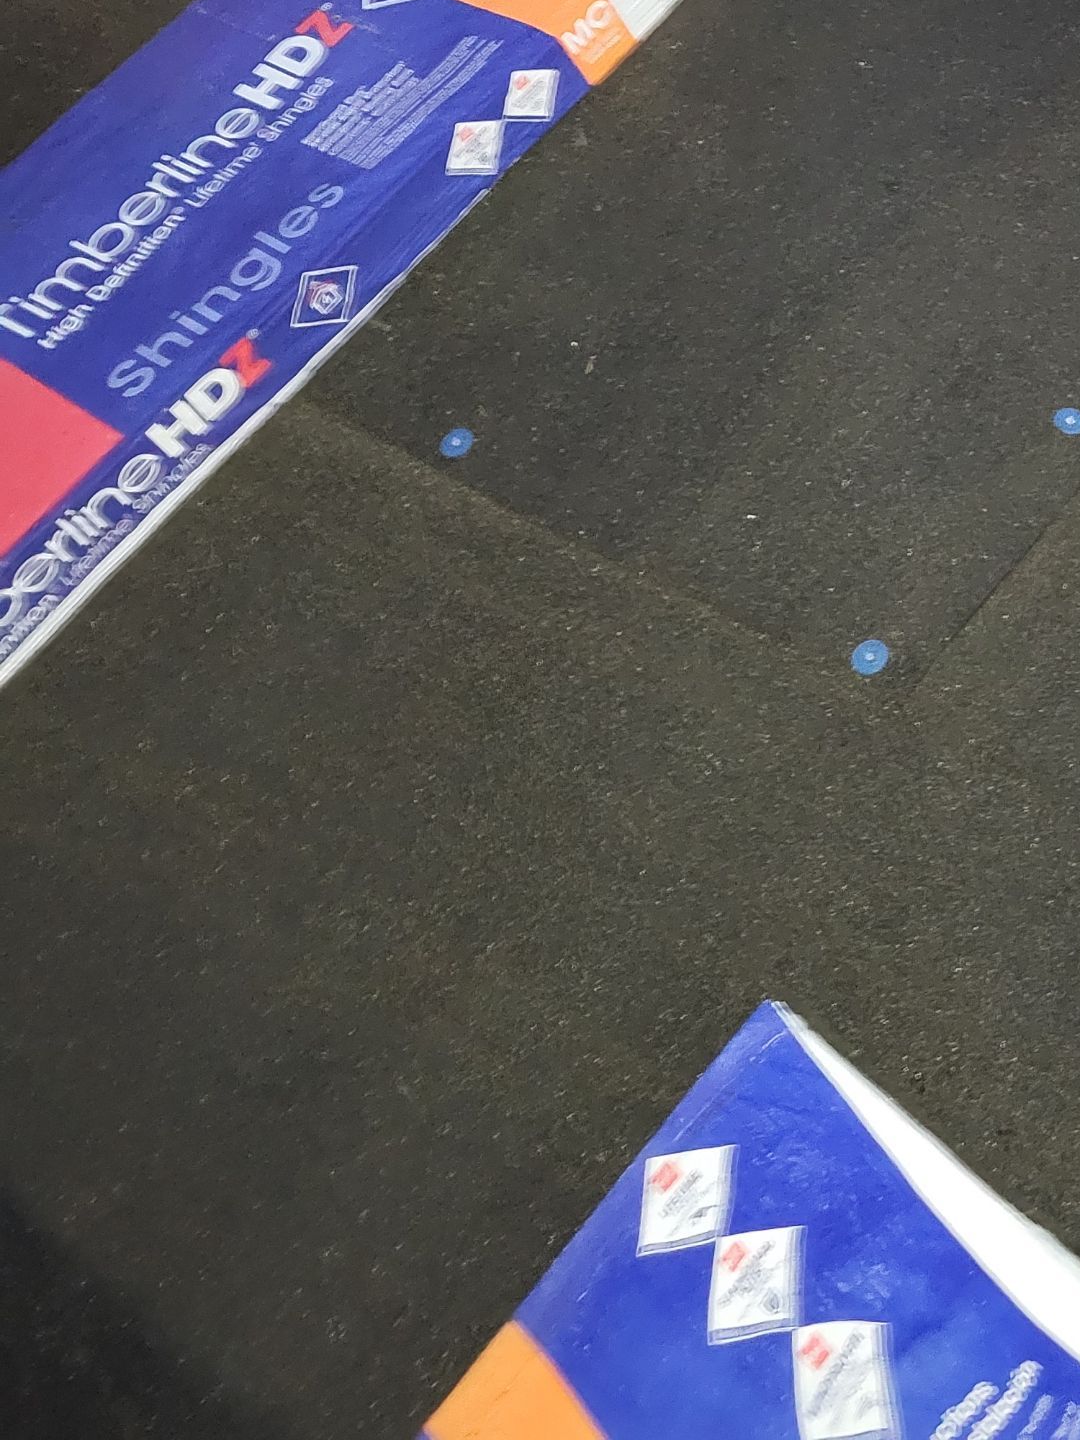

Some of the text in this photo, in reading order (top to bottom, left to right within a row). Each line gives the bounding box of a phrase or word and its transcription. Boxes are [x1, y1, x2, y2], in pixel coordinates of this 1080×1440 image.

[560, 0, 612, 56] MC
[37, 301, 93, 351] High
[88, 206, 186, 310] Definition
[184, 140, 262, 211] Lifetime
[256, 75, 335, 146] Shingles
[106, 180, 346, 399] Shingles
